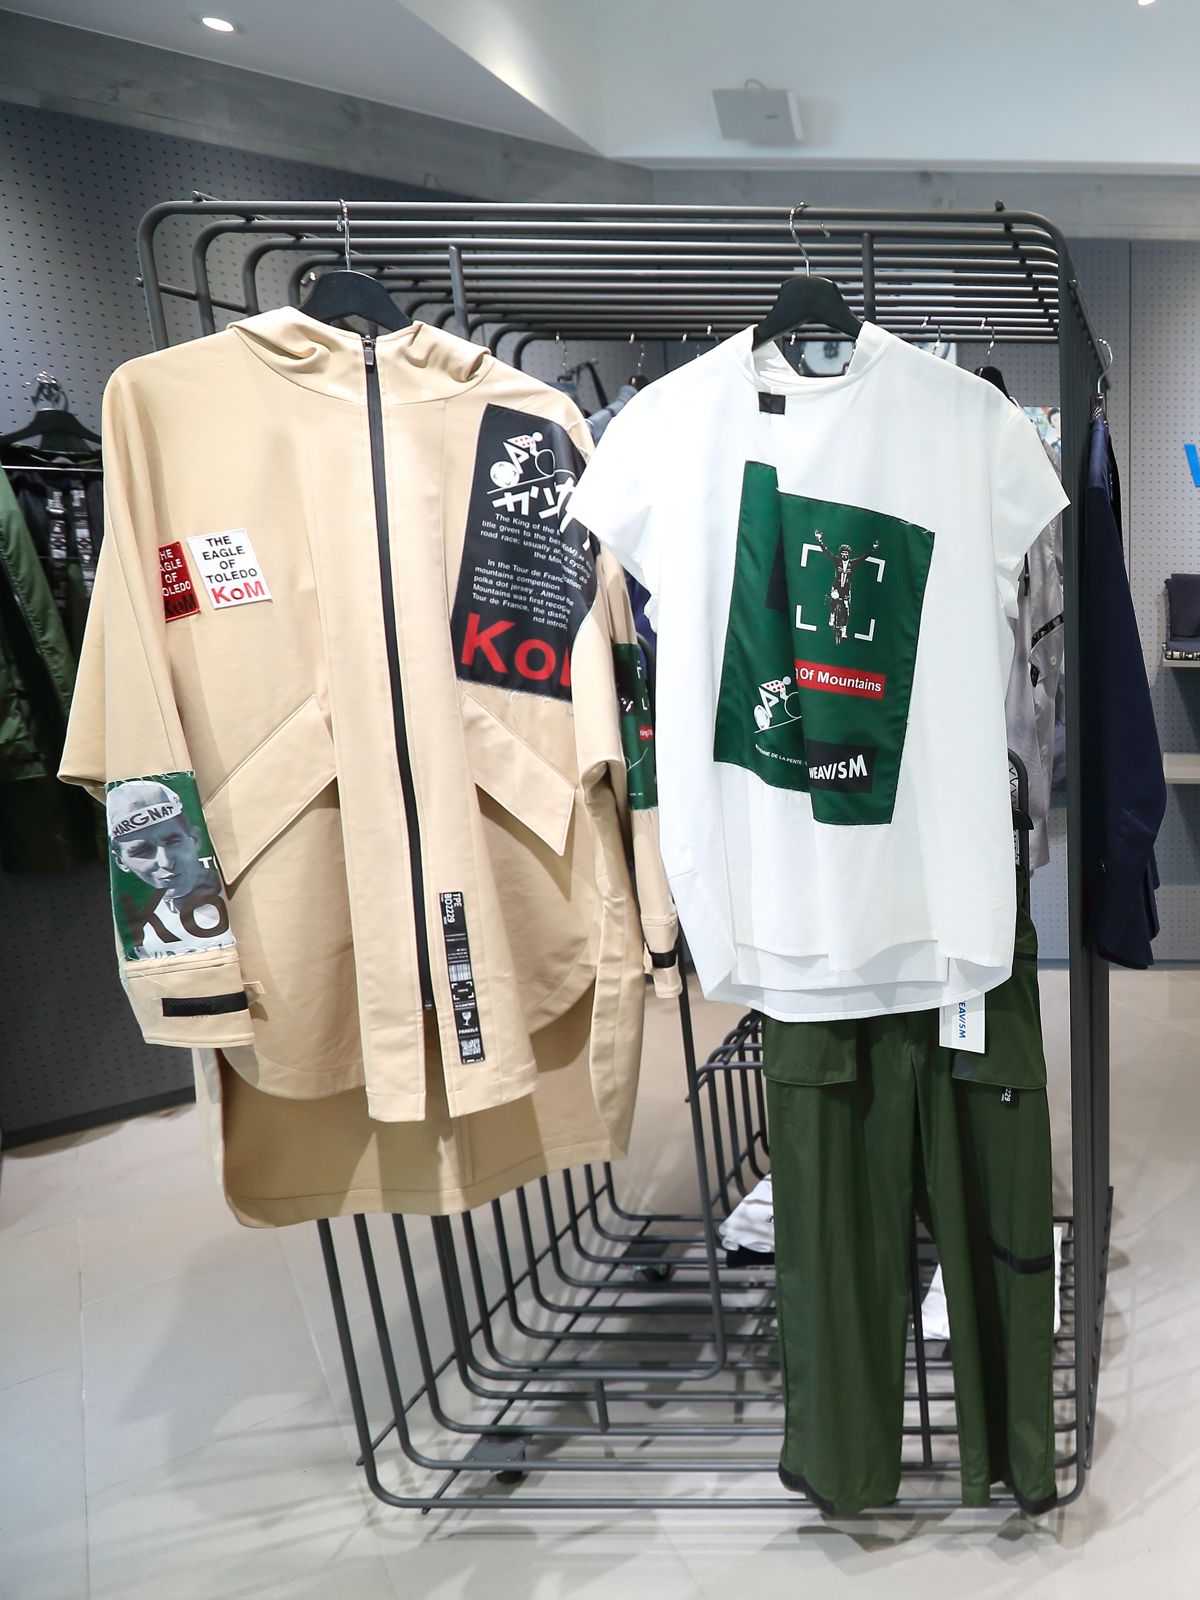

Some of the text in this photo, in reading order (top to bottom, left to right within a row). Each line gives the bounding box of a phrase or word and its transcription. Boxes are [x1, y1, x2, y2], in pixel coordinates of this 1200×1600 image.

[482, 520, 496, 529] title
[499, 524, 520, 535] given
[534, 533, 546, 541] the
[495, 513, 510, 523] The
[512, 517, 530, 529] King
[532, 522, 540, 530] of
[542, 525, 555, 534] the
[206, 535, 232, 547] THE
[480, 530, 498, 539] road
[523, 540, 551, 553] usually
[202, 546, 245, 561] EAGLE
[534, 551, 546, 560] the
[219, 559, 236, 570] OF
[488, 559, 495, 567] In
[497, 561, 510, 570] the
[512, 564, 529, 574] Tour
[531, 568, 541, 577] de
[164, 572, 178, 584] OF
[206, 568, 258, 583] TOLEDO
[473, 575, 493, 586] polka
[495, 579, 509, 588] dot
[510, 583, 534, 594] jersey
[474, 566, 560, 591] mountains competition
[212, 580, 265, 604] KoM
[473, 584, 511, 599] Mountains
[512, 593, 527, 601] was
[529, 596, 544, 605] first
[472, 592, 487, 602] Tour
[489, 597, 499, 605] de
[533, 606, 545, 615] the
[533, 616, 545, 624] not
[800, 668, 815, 680] Of
[817, 671, 882, 692] Mountains
[113, 805, 174, 837] MARGNAT
